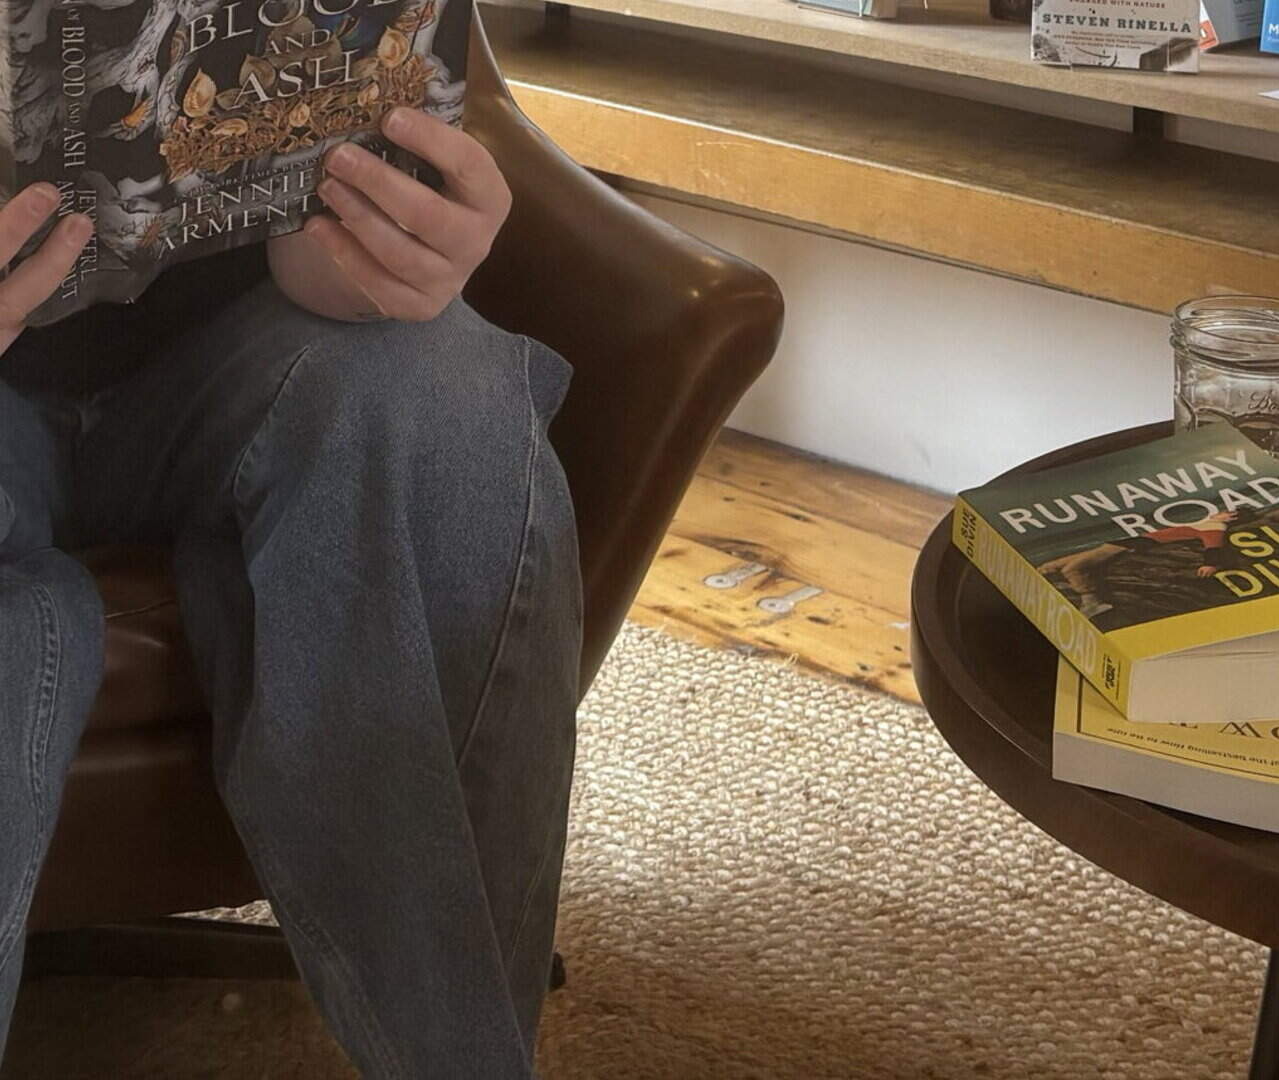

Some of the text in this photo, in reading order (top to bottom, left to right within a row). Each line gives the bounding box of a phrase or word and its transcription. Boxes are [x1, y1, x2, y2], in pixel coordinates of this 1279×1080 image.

[265, 28, 331, 57] AND
[1042, 13, 1192, 33] STEVEN RINELLA
[61, 25, 85, 100] BLOOD
[231, 50, 361, 111] ASH
[63, 127, 86, 169] ASH
[999, 449, 1261, 535] RUNAWAY
[1249, 757, 1267, 766] the
